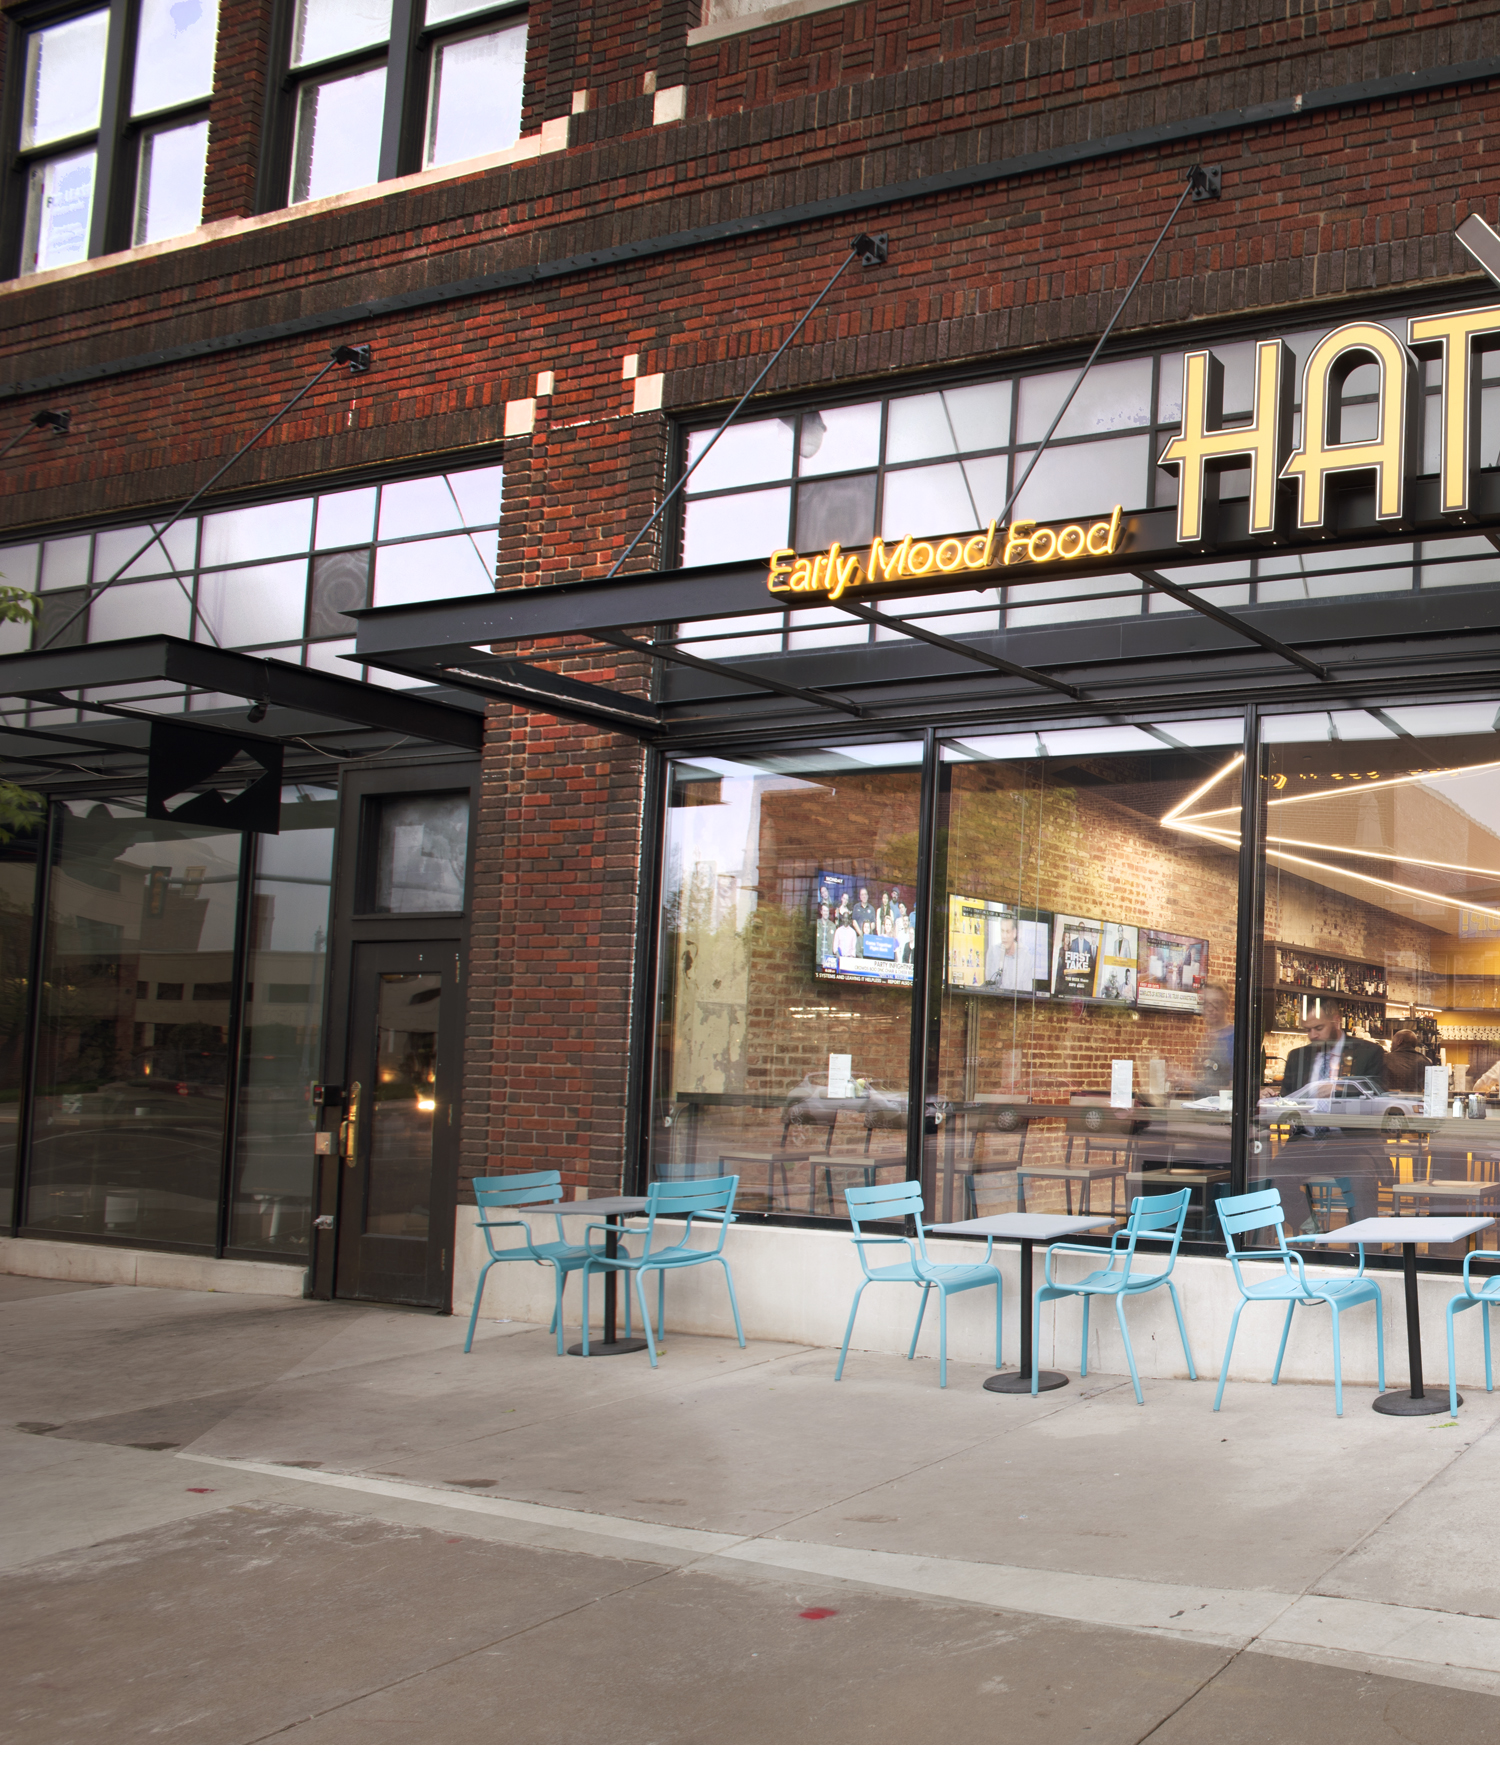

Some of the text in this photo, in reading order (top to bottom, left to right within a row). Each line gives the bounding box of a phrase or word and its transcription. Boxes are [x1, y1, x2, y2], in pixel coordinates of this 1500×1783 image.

[767, 504, 1123, 600] Early Mood Food
[1065, 951, 1091, 963] FIRST
[1065, 960, 1089, 971] TAKE
